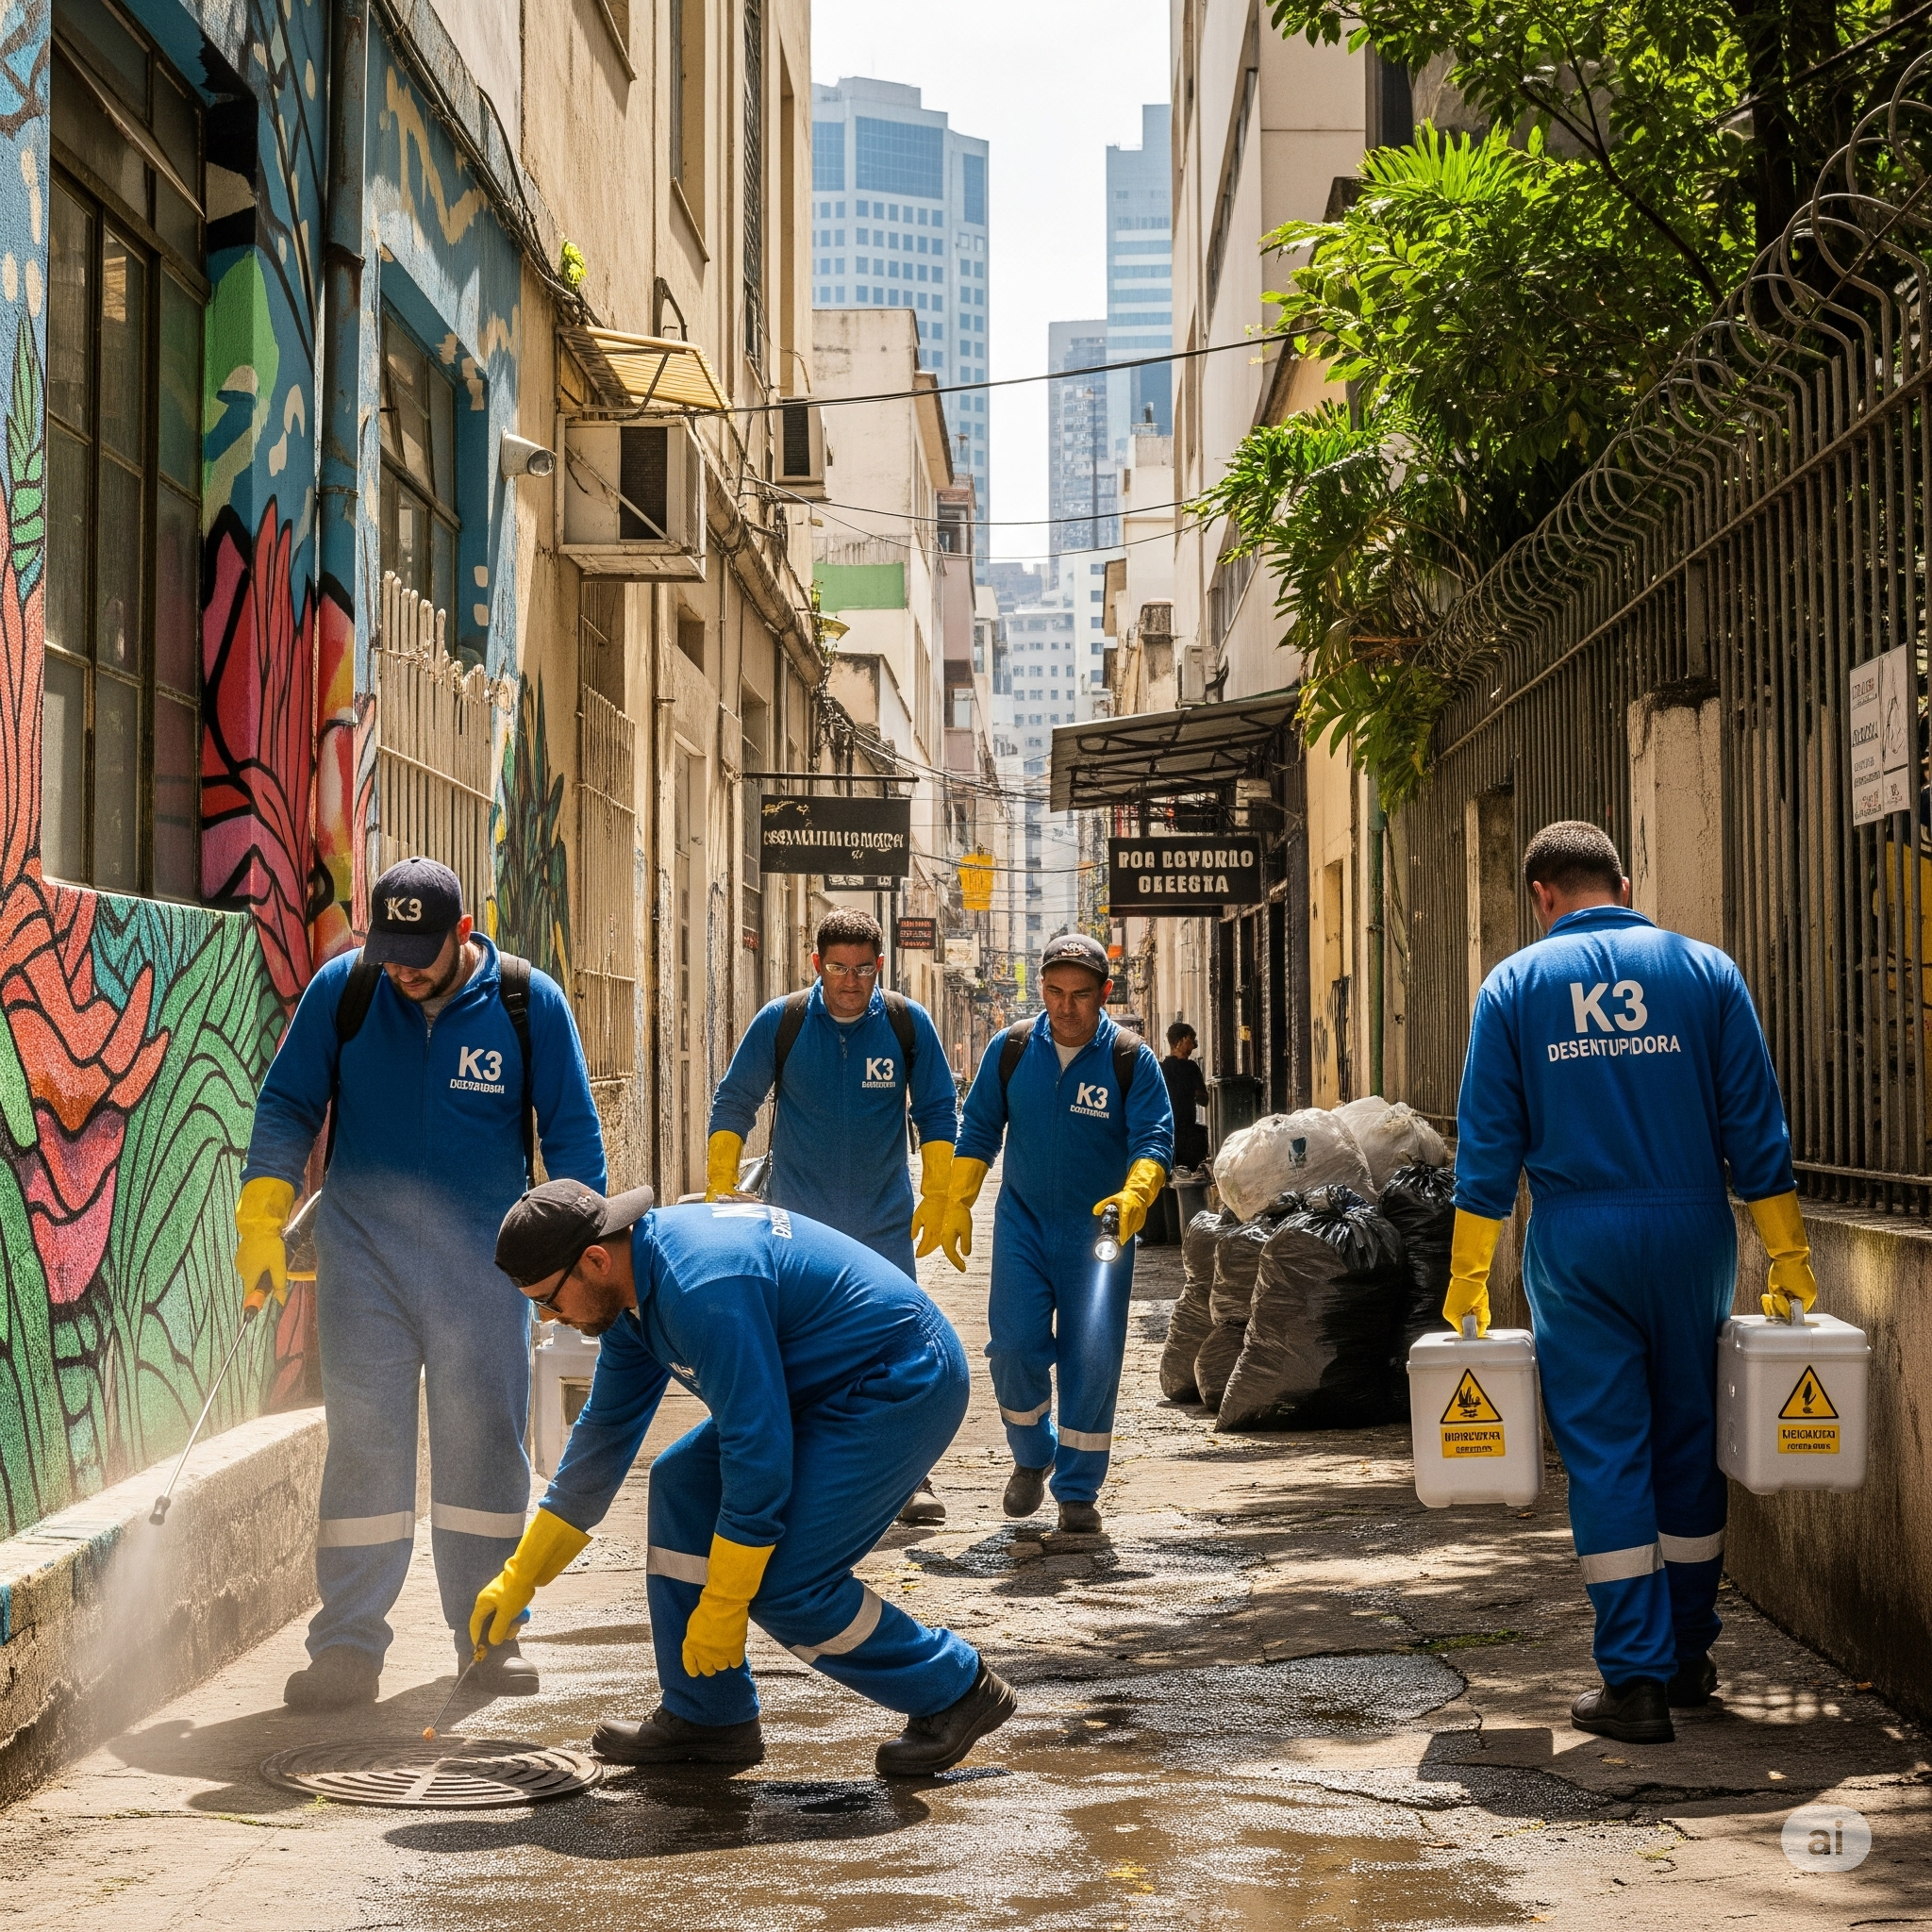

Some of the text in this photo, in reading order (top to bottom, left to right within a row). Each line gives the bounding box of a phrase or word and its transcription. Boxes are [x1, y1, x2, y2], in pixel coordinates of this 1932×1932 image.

[384, 896, 423, 922] K3
[1570, 979, 1649, 1034] K3
[458, 1045, 503, 1082] K3
[866, 1058, 894, 1081] K3
[1075, 1082, 1108, 1110] K3
